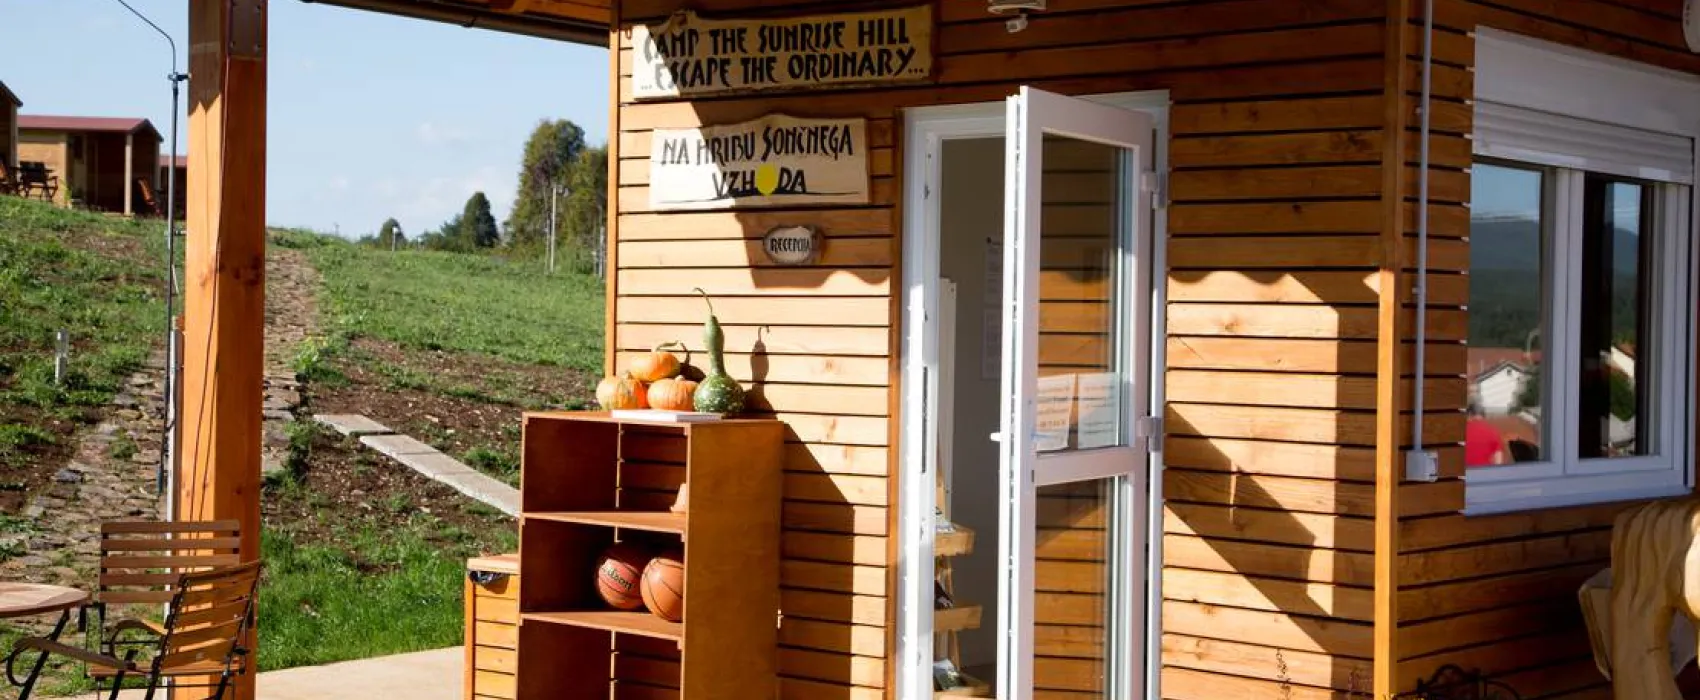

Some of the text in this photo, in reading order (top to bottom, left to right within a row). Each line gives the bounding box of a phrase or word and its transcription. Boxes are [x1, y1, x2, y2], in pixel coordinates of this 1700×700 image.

[644, 17, 909, 63] CAMP THE SUNRISE HILL
[740, 56, 778, 84] THE
[660, 138, 690, 166] NA
[696, 131, 756, 166] HRIBU
